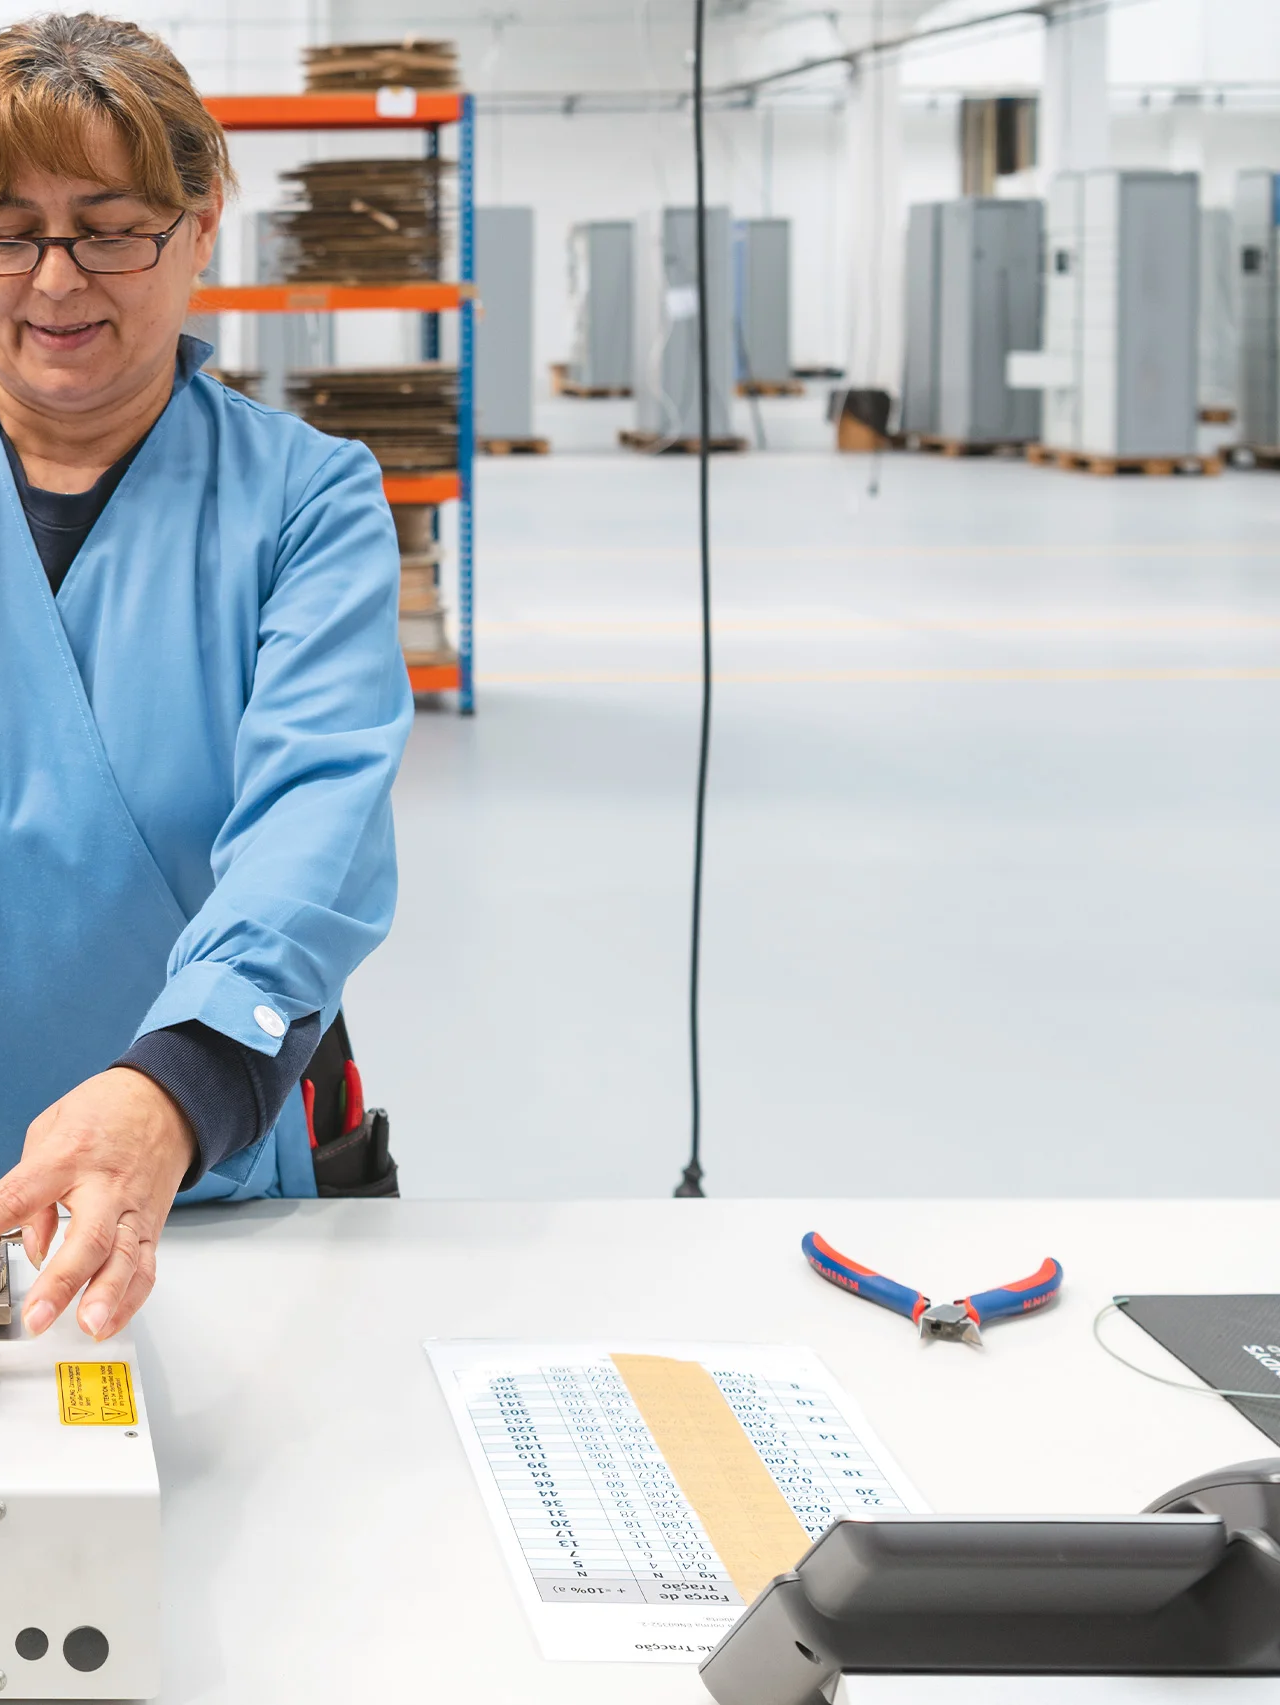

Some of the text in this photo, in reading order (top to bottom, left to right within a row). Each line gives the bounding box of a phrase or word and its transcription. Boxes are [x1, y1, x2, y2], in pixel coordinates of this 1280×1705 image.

[764, 1457, 799, 1465] 1,00
[632, 1462, 666, 1470] 9,18
[638, 1471, 671, 1479] 8,67
[775, 1476, 812, 1484] 0,75
[640, 1481, 675, 1489] 6,12
[651, 1500, 686, 1509] 3,26
[793, 1505, 830, 1513] 0,25
[655, 1510, 690, 1519] 2,86
[661, 1520, 694, 1529] 1,84
[805, 1525, 830, 1533] ,14
[665, 1531, 698, 1539] 1,53
[670, 1541, 704, 1549] 1,12
[676, 1551, 712, 1560] 0,61
[682, 1562, 707, 1570] 0,4
[699, 1572, 717, 1580] kg
[662, 1583, 718, 1591] Tração
[684, 1593, 730, 1602] Força
[635, 1643, 694, 1653] Tracção
